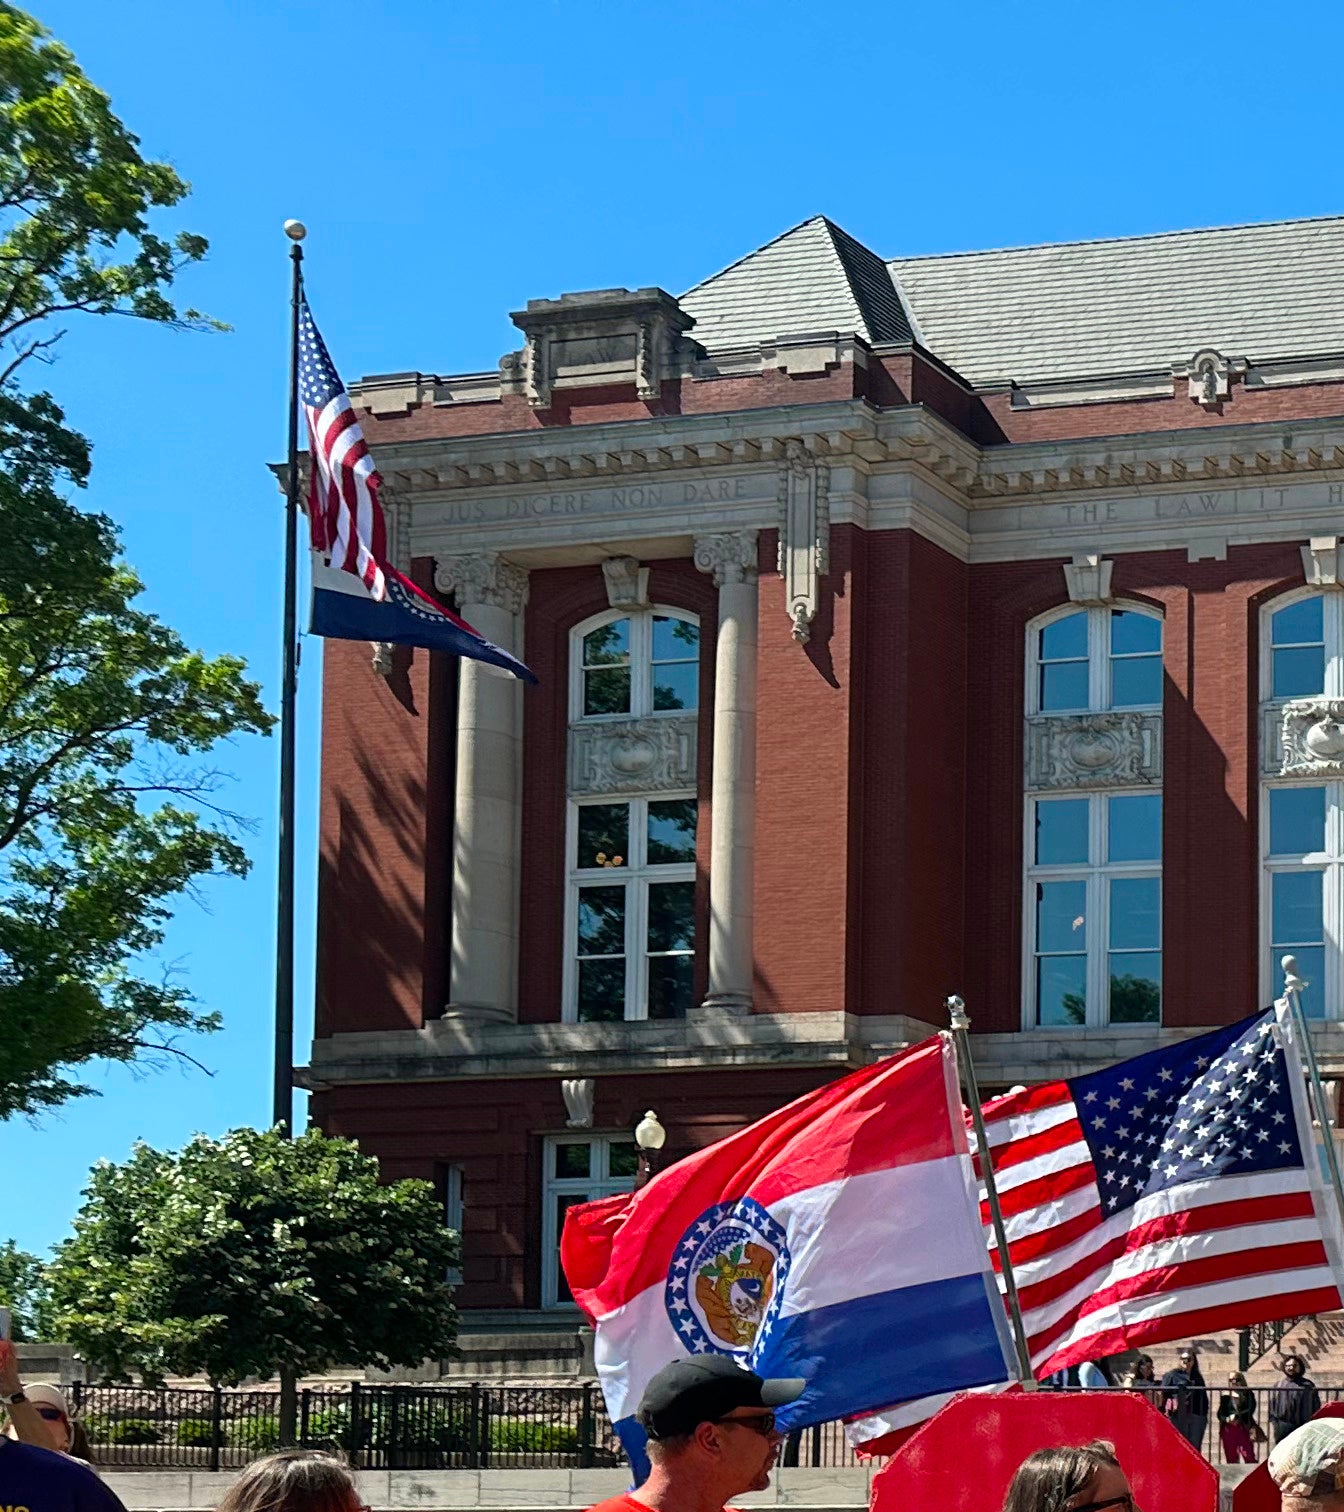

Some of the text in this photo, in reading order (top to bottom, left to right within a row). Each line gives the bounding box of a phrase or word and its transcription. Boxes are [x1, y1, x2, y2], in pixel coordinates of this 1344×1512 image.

[442, 478, 746, 521] JUS DICERE NON DARE
[1062, 502, 1119, 523] THE
[1153, 493, 1222, 518] LAW
[1258, 488, 1289, 508] IT
